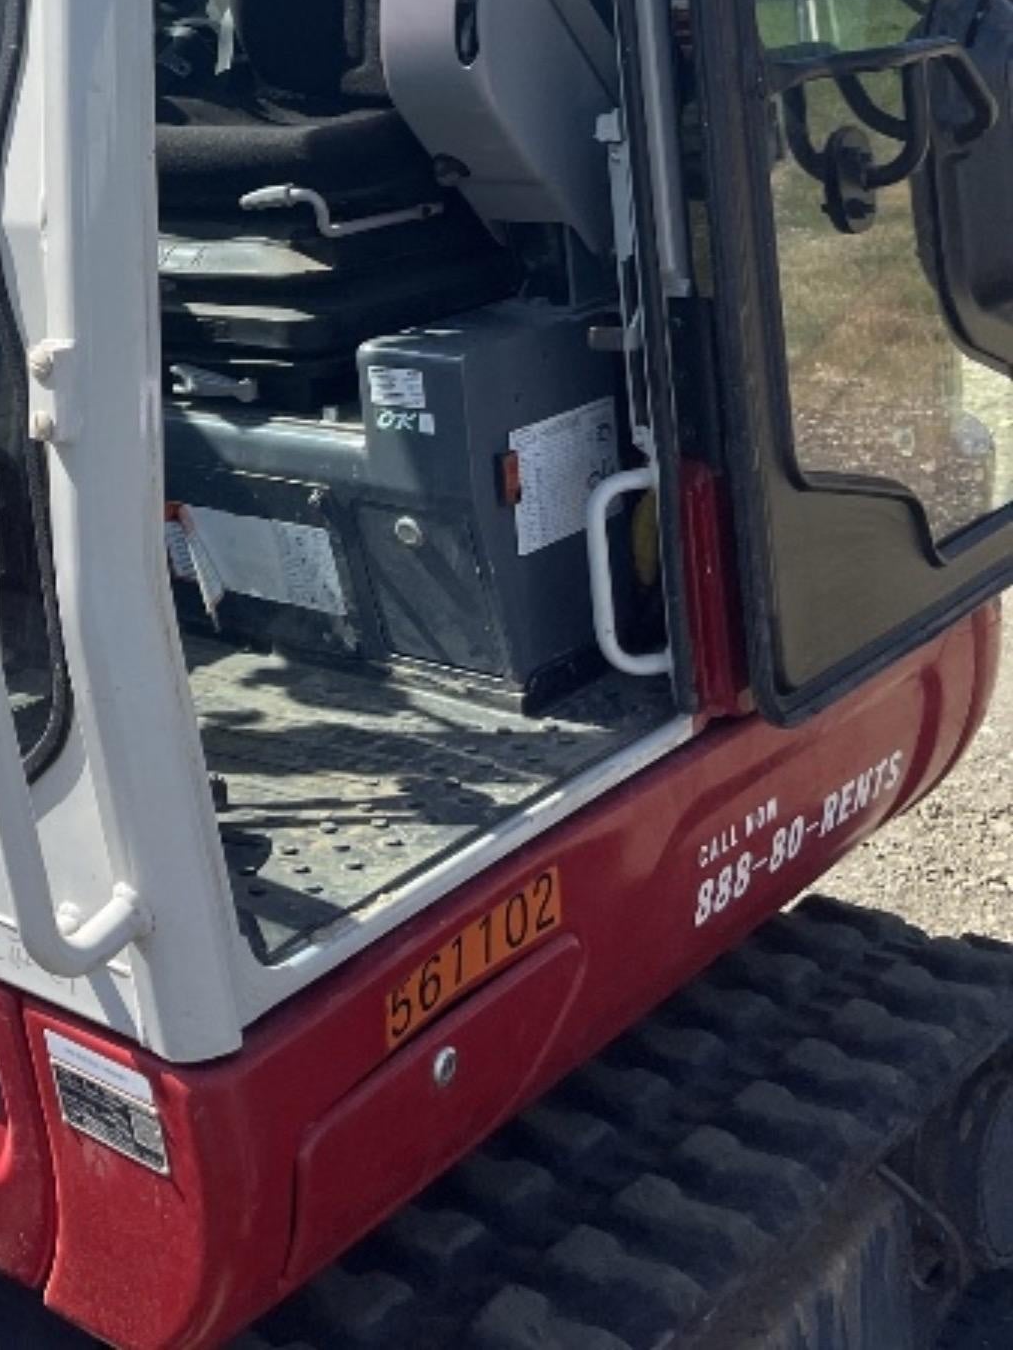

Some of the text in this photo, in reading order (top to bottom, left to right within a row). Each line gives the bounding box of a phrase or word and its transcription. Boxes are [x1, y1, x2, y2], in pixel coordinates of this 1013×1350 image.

[694, 749, 903, 928] 888-80-RENTS
[698, 824, 738, 868] CALL
[391, 872, 555, 1038] 561102
